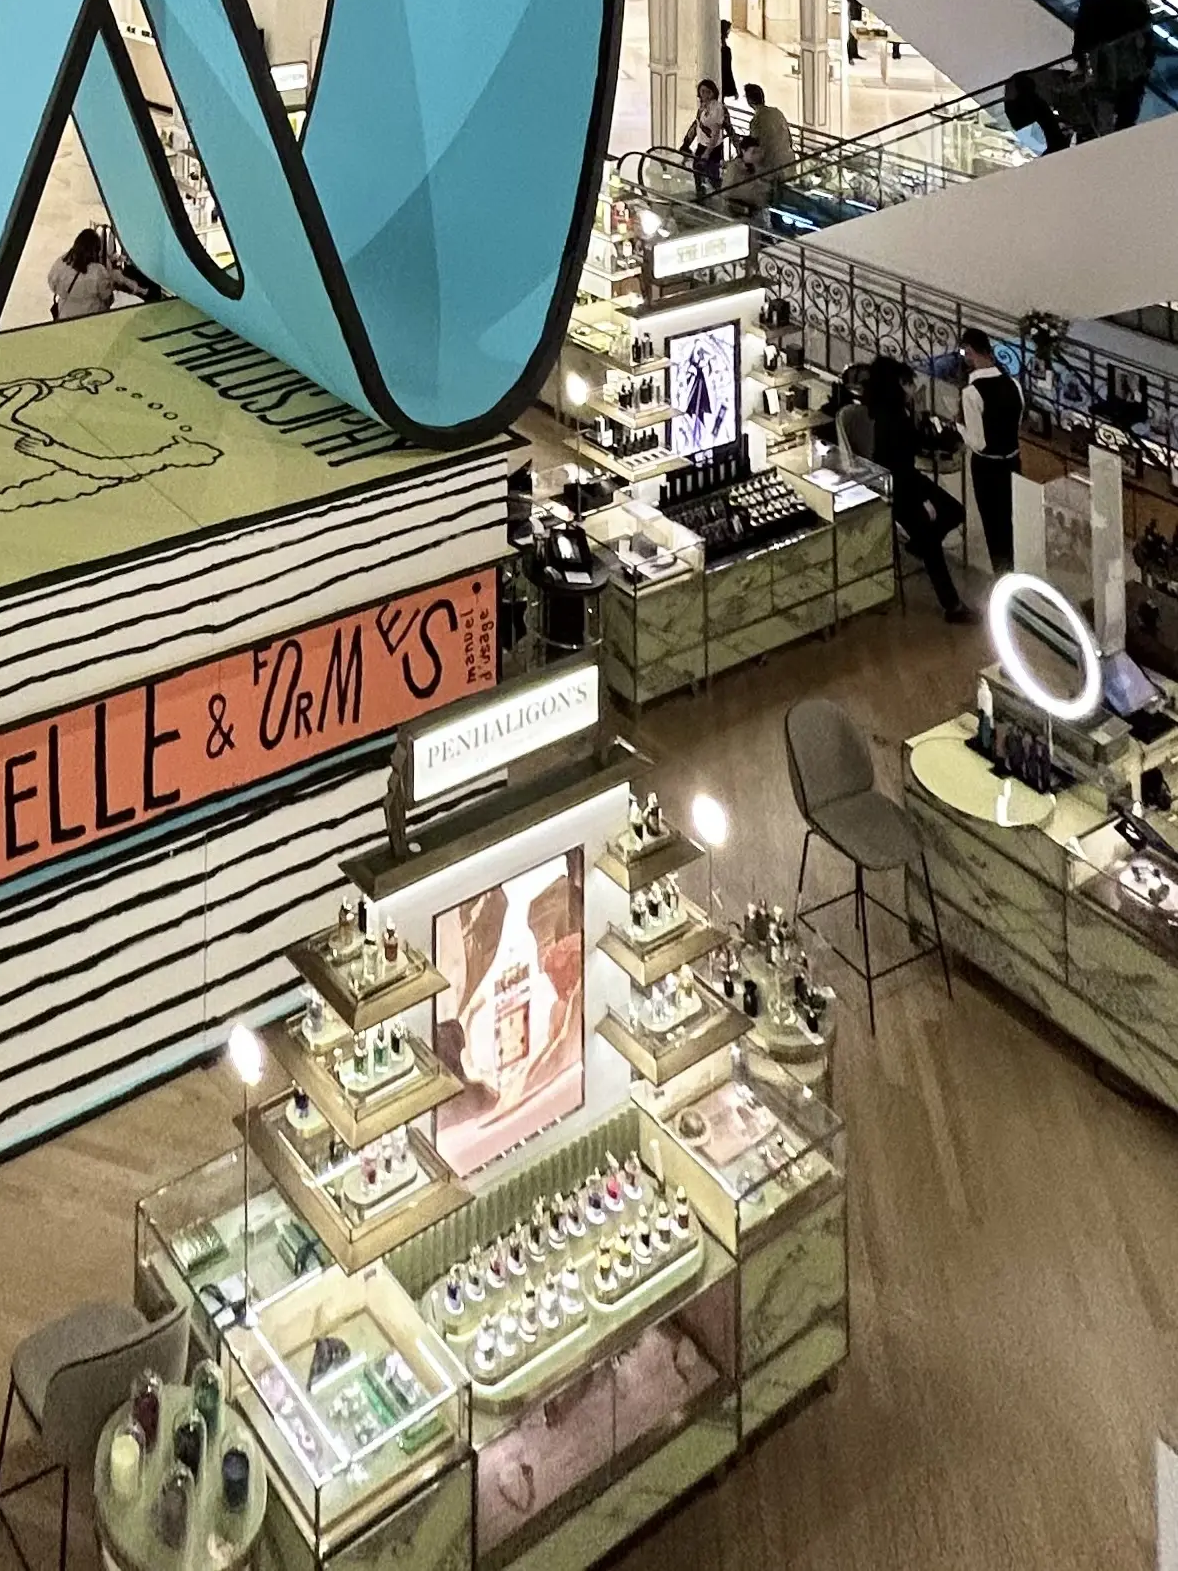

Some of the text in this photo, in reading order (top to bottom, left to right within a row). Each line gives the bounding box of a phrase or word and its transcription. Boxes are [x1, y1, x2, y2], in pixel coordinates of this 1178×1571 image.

[206, 692, 236, 760] &
[253, 597, 458, 751] FORMES
[427, 681, 588, 769] PENHALIGON'S
